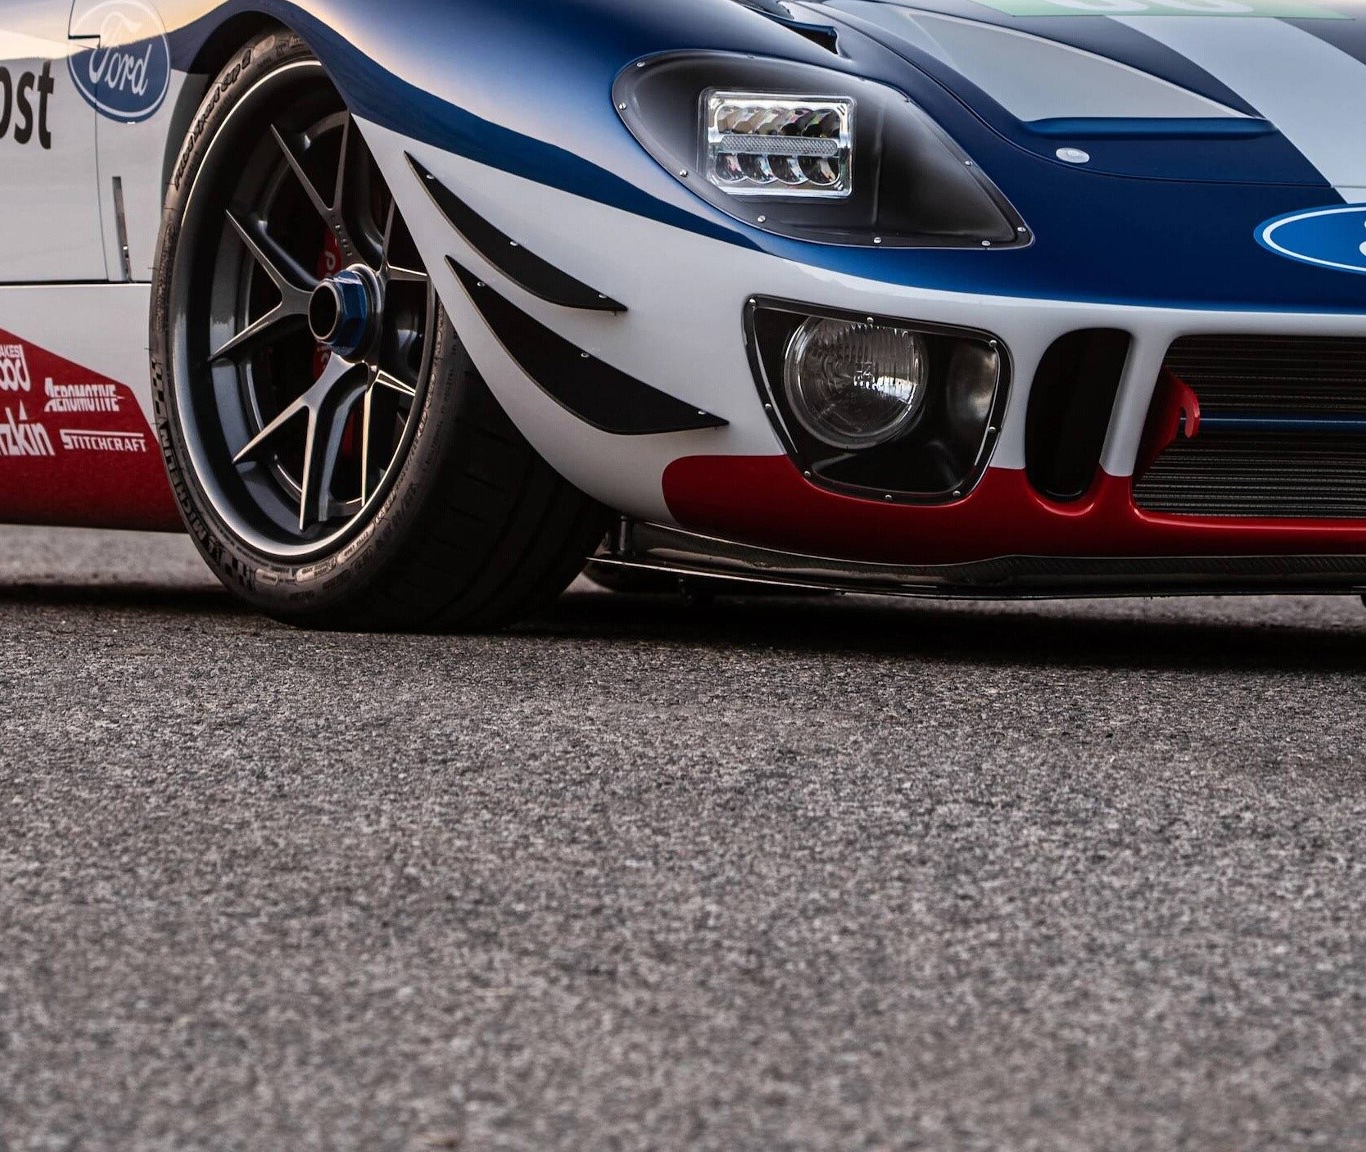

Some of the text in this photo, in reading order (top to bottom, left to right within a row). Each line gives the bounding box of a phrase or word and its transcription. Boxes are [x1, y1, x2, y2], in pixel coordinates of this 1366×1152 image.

[88, 11, 153, 97] Ford
[60, 429, 147, 453] STITCHCRAFT
[158, 425, 208, 541] MICHELIN
